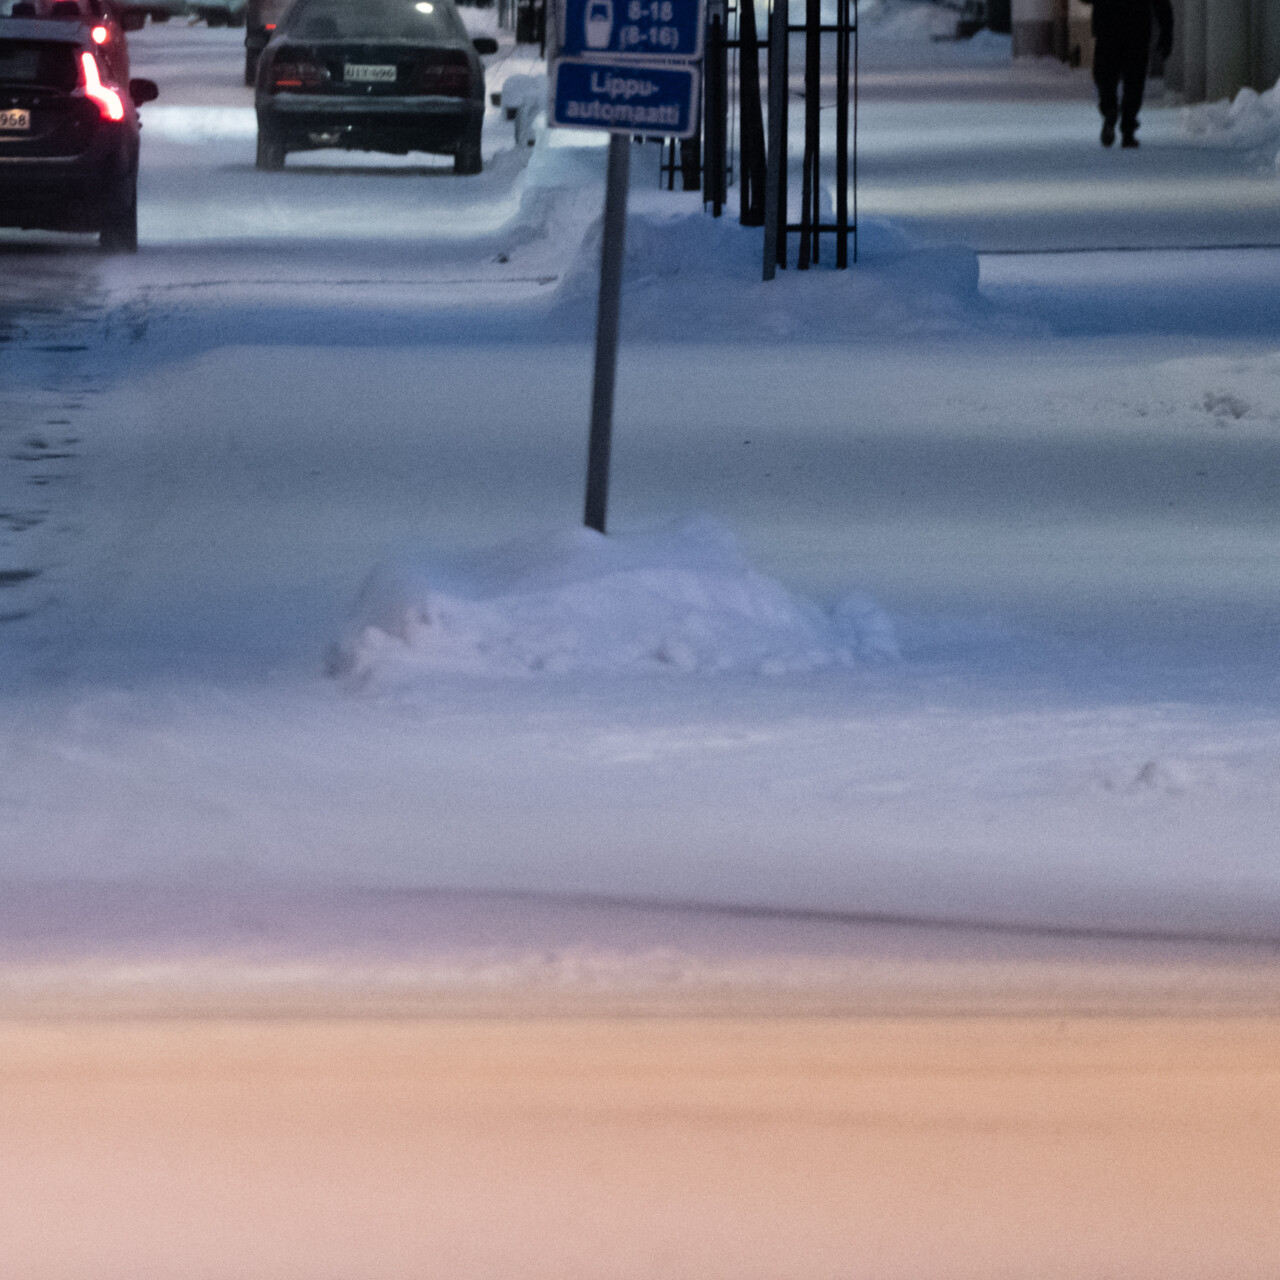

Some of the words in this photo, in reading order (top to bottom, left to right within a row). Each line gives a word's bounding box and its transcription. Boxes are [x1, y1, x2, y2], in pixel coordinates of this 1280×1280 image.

[628, 0, 673, 20] 8-18
[620, 23, 679, 48] (8-16)
[590, 71, 660, 101] Lippu-
[565, 97, 680, 124] automaatti
